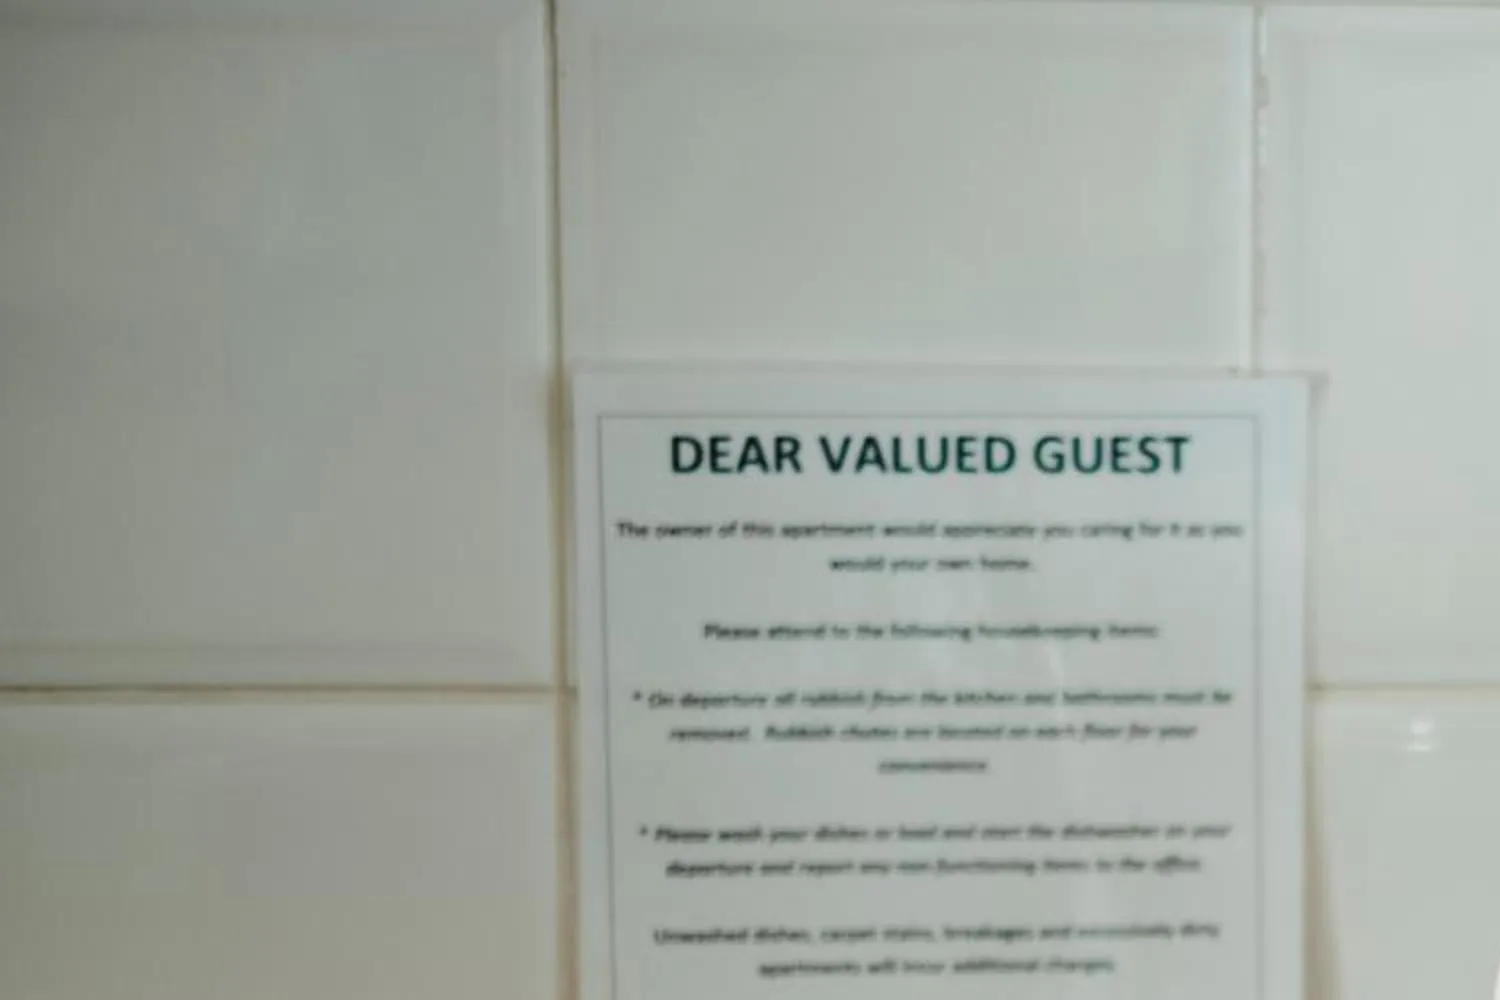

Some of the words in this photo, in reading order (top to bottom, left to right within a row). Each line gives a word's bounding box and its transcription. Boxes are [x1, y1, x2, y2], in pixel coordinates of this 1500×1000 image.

[671, 436, 801, 473] DEAR
[819, 436, 1016, 473] VALUED
[1033, 436, 1189, 474] GUEST
[616, 521, 651, 538] The
[703, 623, 762, 641] Please
[654, 826, 713, 844] Please
